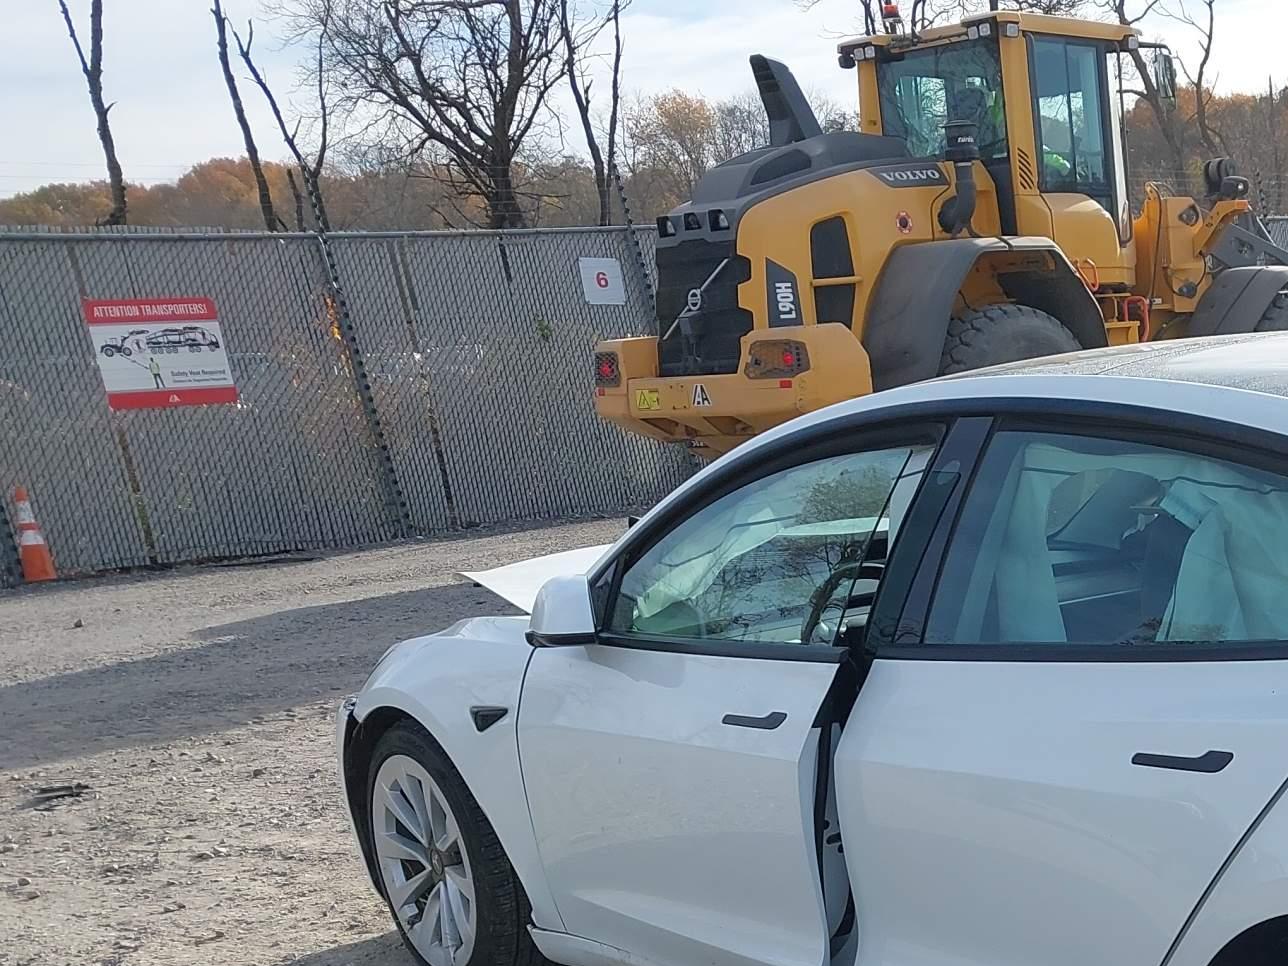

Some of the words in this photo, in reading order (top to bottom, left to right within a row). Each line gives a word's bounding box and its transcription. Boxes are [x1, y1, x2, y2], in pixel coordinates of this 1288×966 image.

[881, 169, 940, 181] VOLVO
[595, 271, 609, 288] 6
[775, 282, 796, 319] L90H
[94, 305, 140, 318] ATTENTION
[141, 303, 208, 316] TRANSPORTERS!
